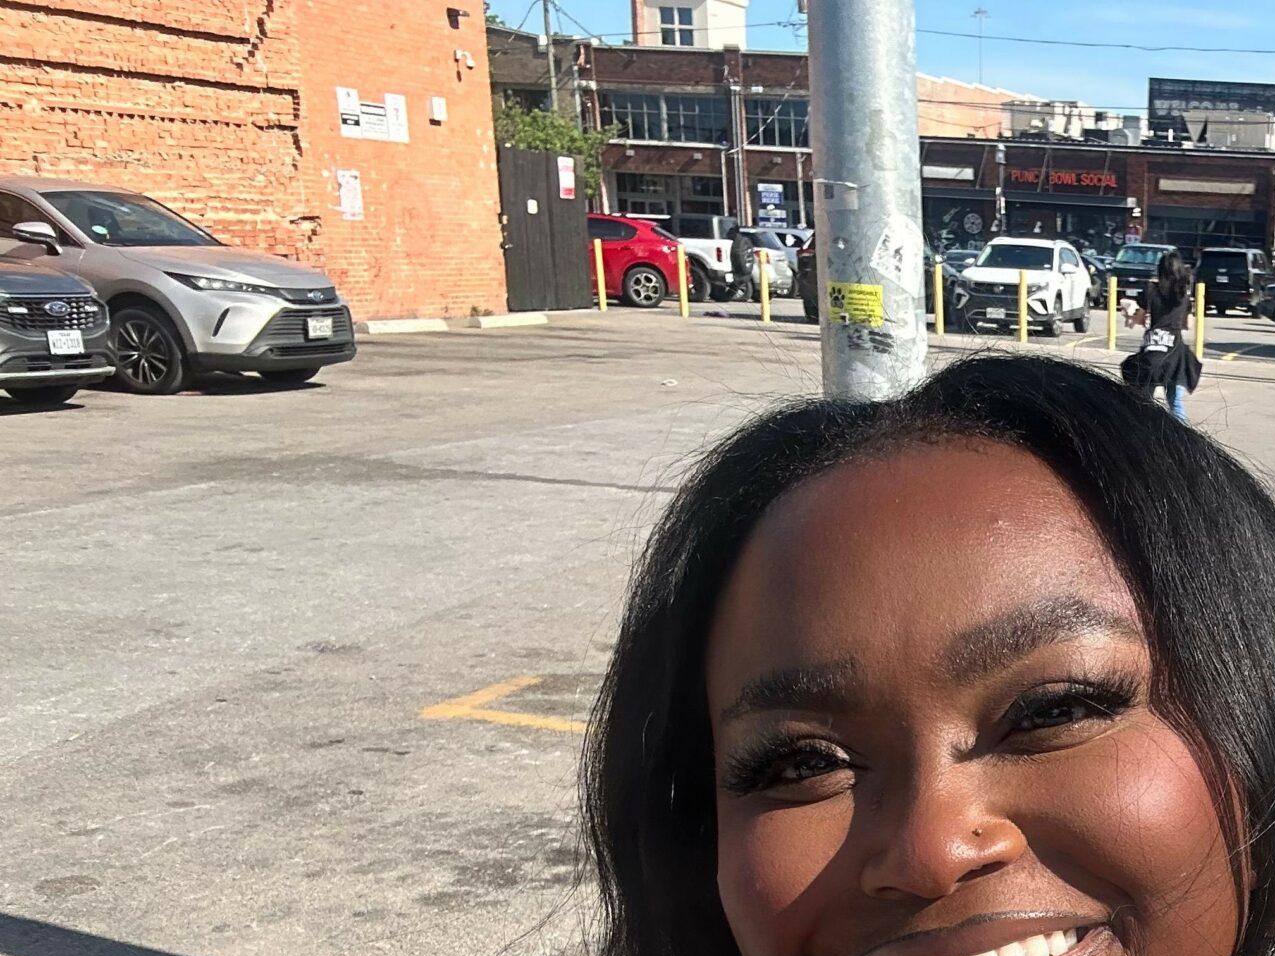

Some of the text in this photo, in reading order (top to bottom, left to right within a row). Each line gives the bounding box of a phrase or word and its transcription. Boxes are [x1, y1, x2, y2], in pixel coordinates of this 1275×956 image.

[1010, 169, 1118, 188] PUNC BOWL SOCIAL
